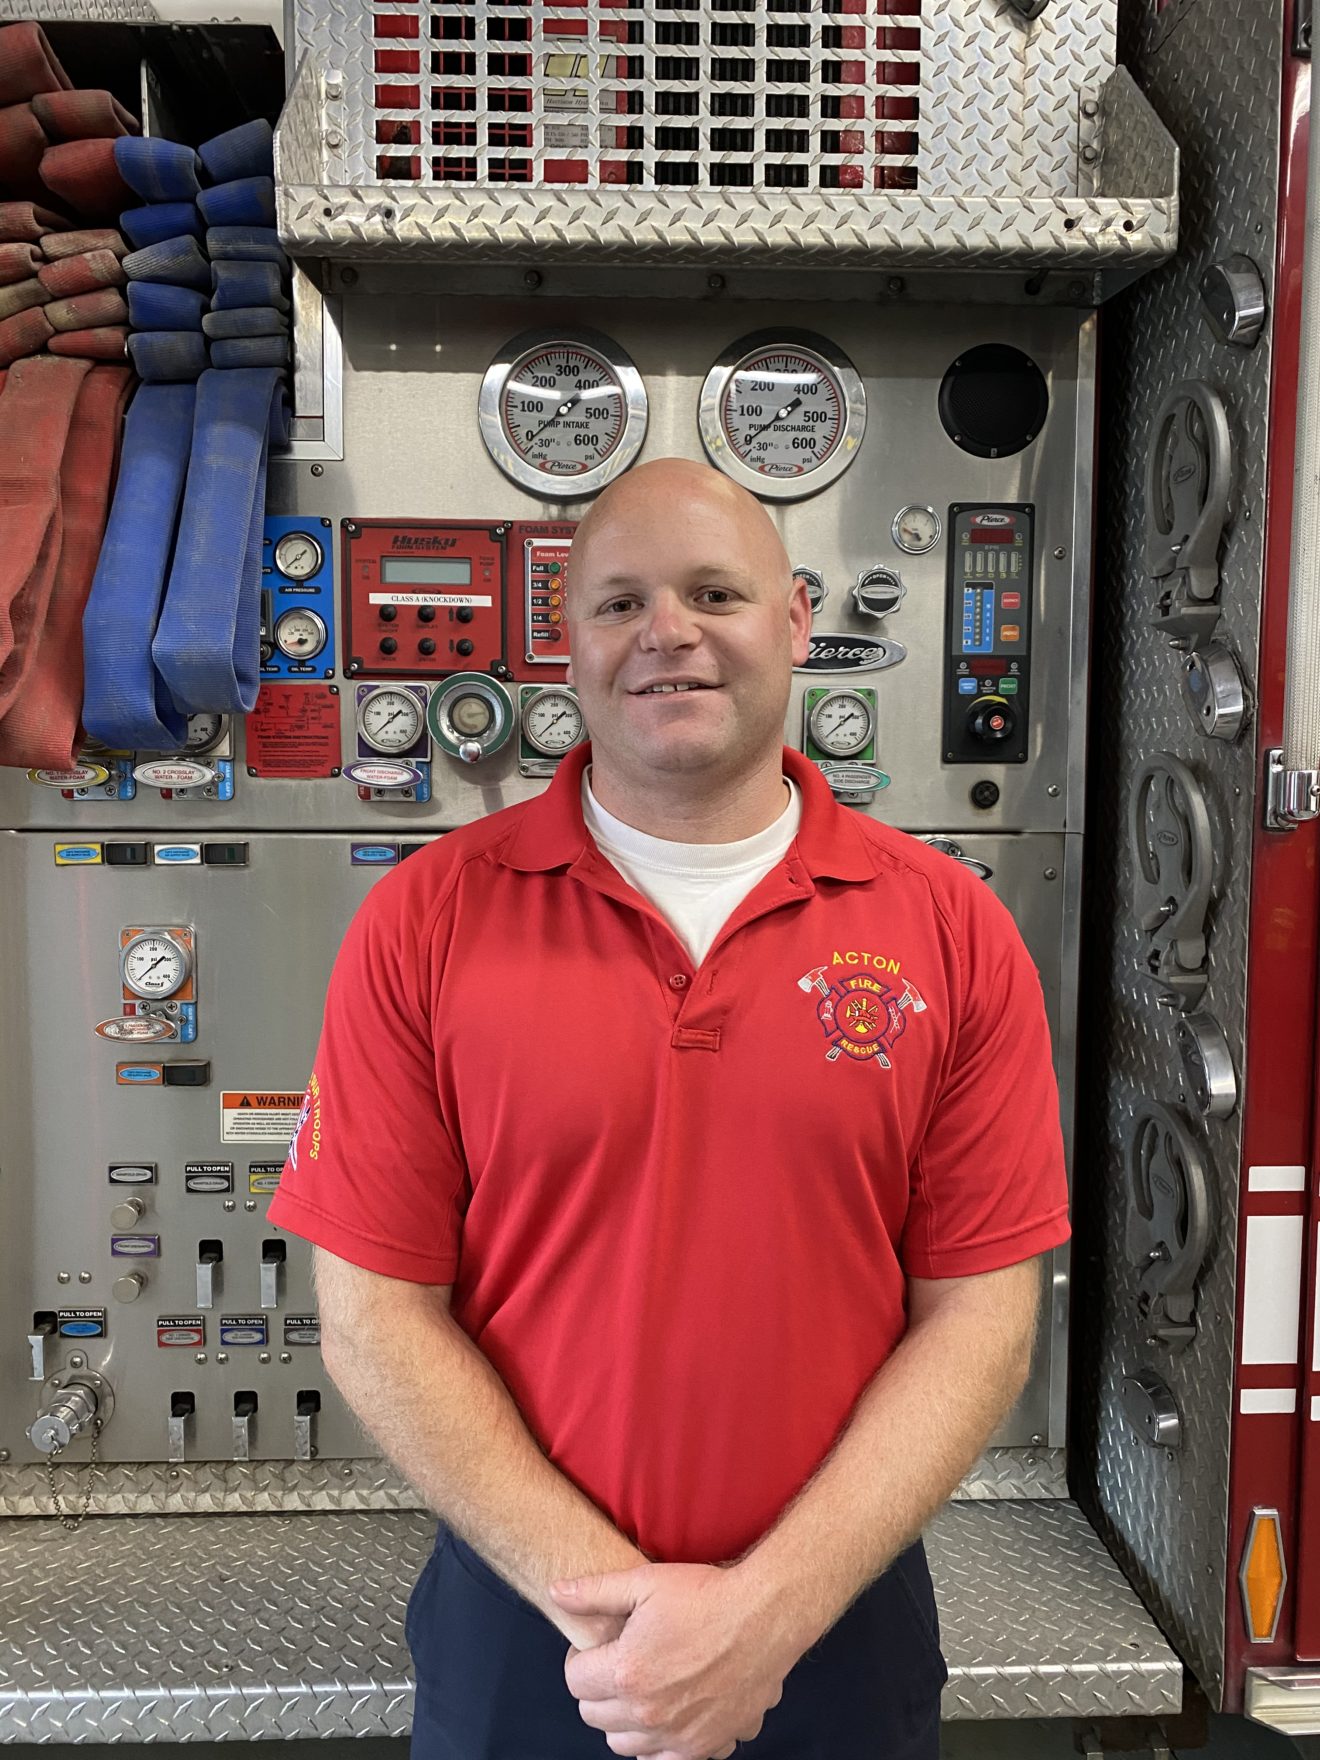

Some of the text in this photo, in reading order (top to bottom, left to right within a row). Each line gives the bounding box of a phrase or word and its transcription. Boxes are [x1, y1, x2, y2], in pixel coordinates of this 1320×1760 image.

[555, 364, 580, 377] 300
[531, 375, 557, 388] 200
[574, 379, 599, 391] 400
[750, 380, 775, 391] 200
[793, 383, 818, 395] 400
[520, 400, 544, 413] 100
[739, 404, 762, 416] 100
[585, 407, 609, 420] 500
[803, 411, 827, 423] 500
[538, 420, 590, 429] PUMP INTAKE
[748, 423, 816, 432] PUMP DISCHARGE
[574, 434, 599, 446] 600
[792, 437, 817, 449] 600
[584, 453, 595, 461] psi
[802, 456, 812, 464] psi
[550, 461, 577, 470] Pierce
[768, 464, 793, 473] Pierce
[980, 515, 1006, 524] Pierce
[519, 526, 549, 534] FOAM
[391, 535, 457, 547] Husky
[832, 951, 901, 975] ACTON
[849, 978, 882, 993] FIRE
[840, 1039, 880, 1054] RESCUE
[309, 1098, 321, 1161] TROOPS
